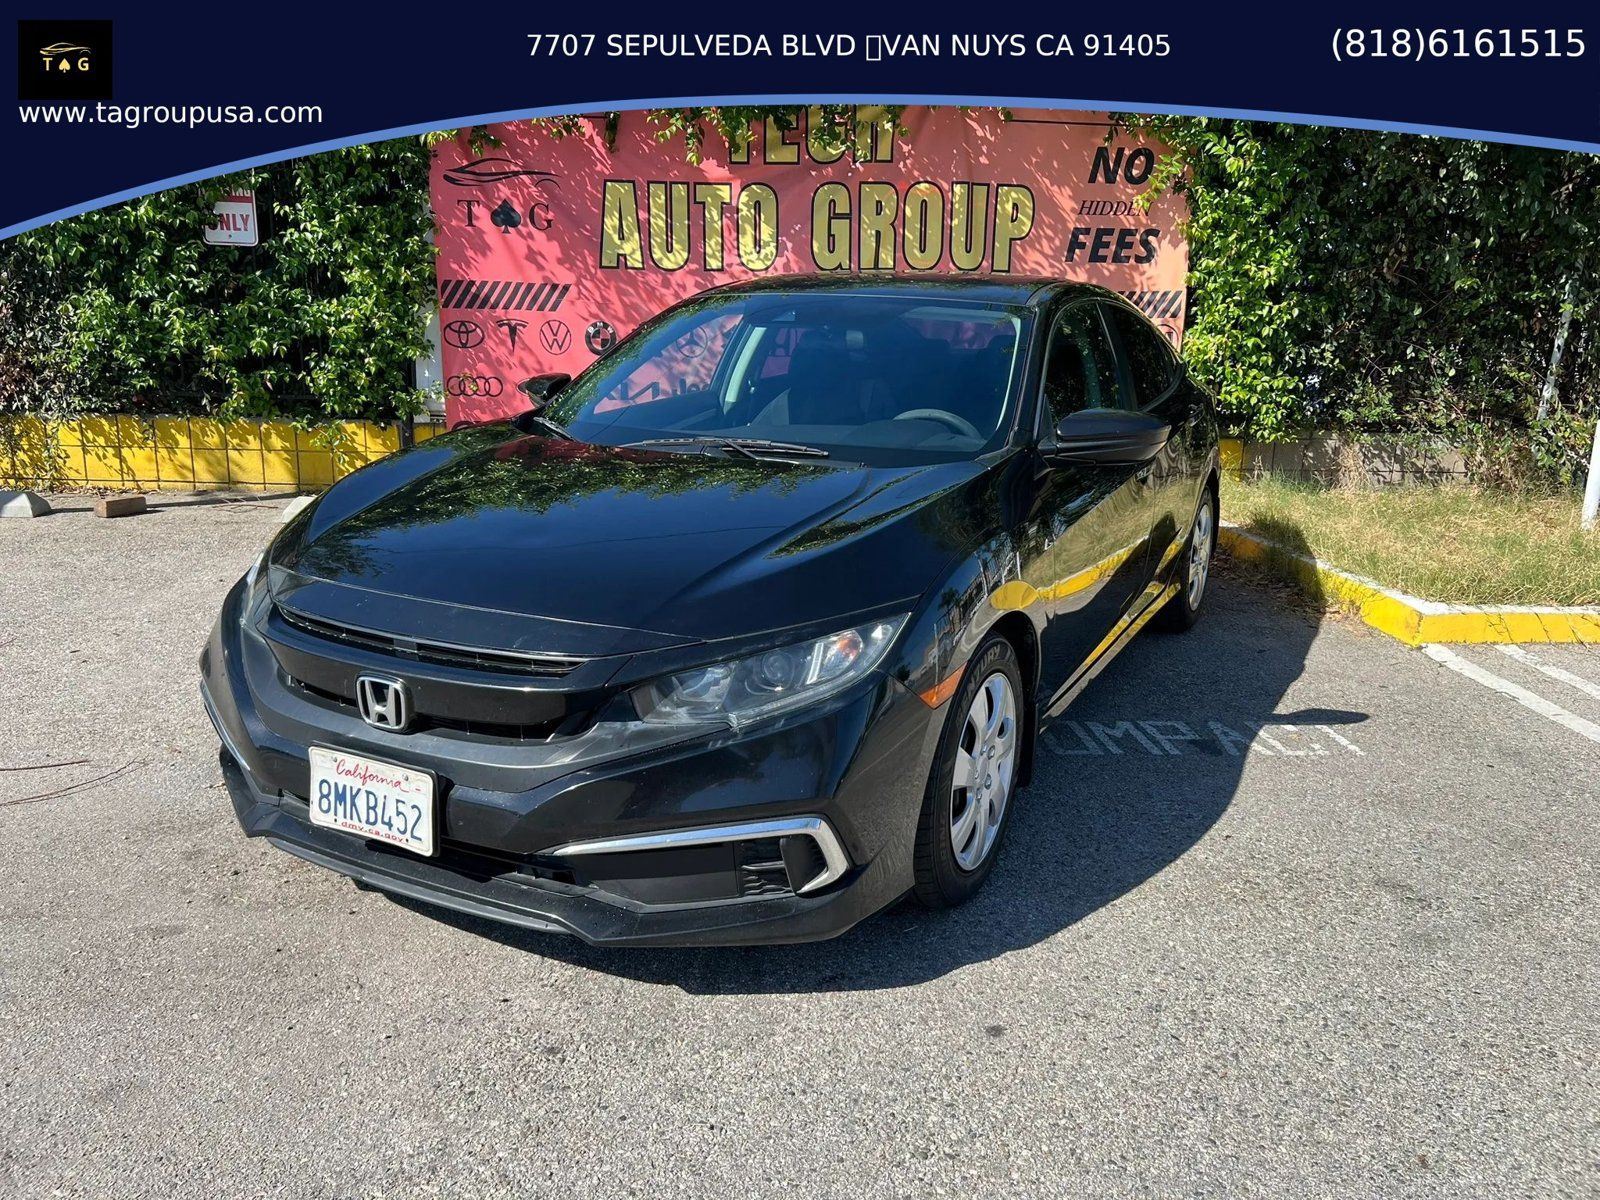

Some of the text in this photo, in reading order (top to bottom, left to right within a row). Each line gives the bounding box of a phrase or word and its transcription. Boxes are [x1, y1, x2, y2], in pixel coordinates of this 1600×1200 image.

[1088, 146, 1156, 185] NO
[207, 212, 250, 232] NLY
[599, 179, 1035, 273] AUTO GROUP
[1078, 199, 1155, 218] HIDDEN
[1064, 227, 1161, 264] FEES
[336, 758, 410, 794] California
[318, 778, 423, 842] 8MKB452
[341, 821, 407, 845] dmv.ca.gov
